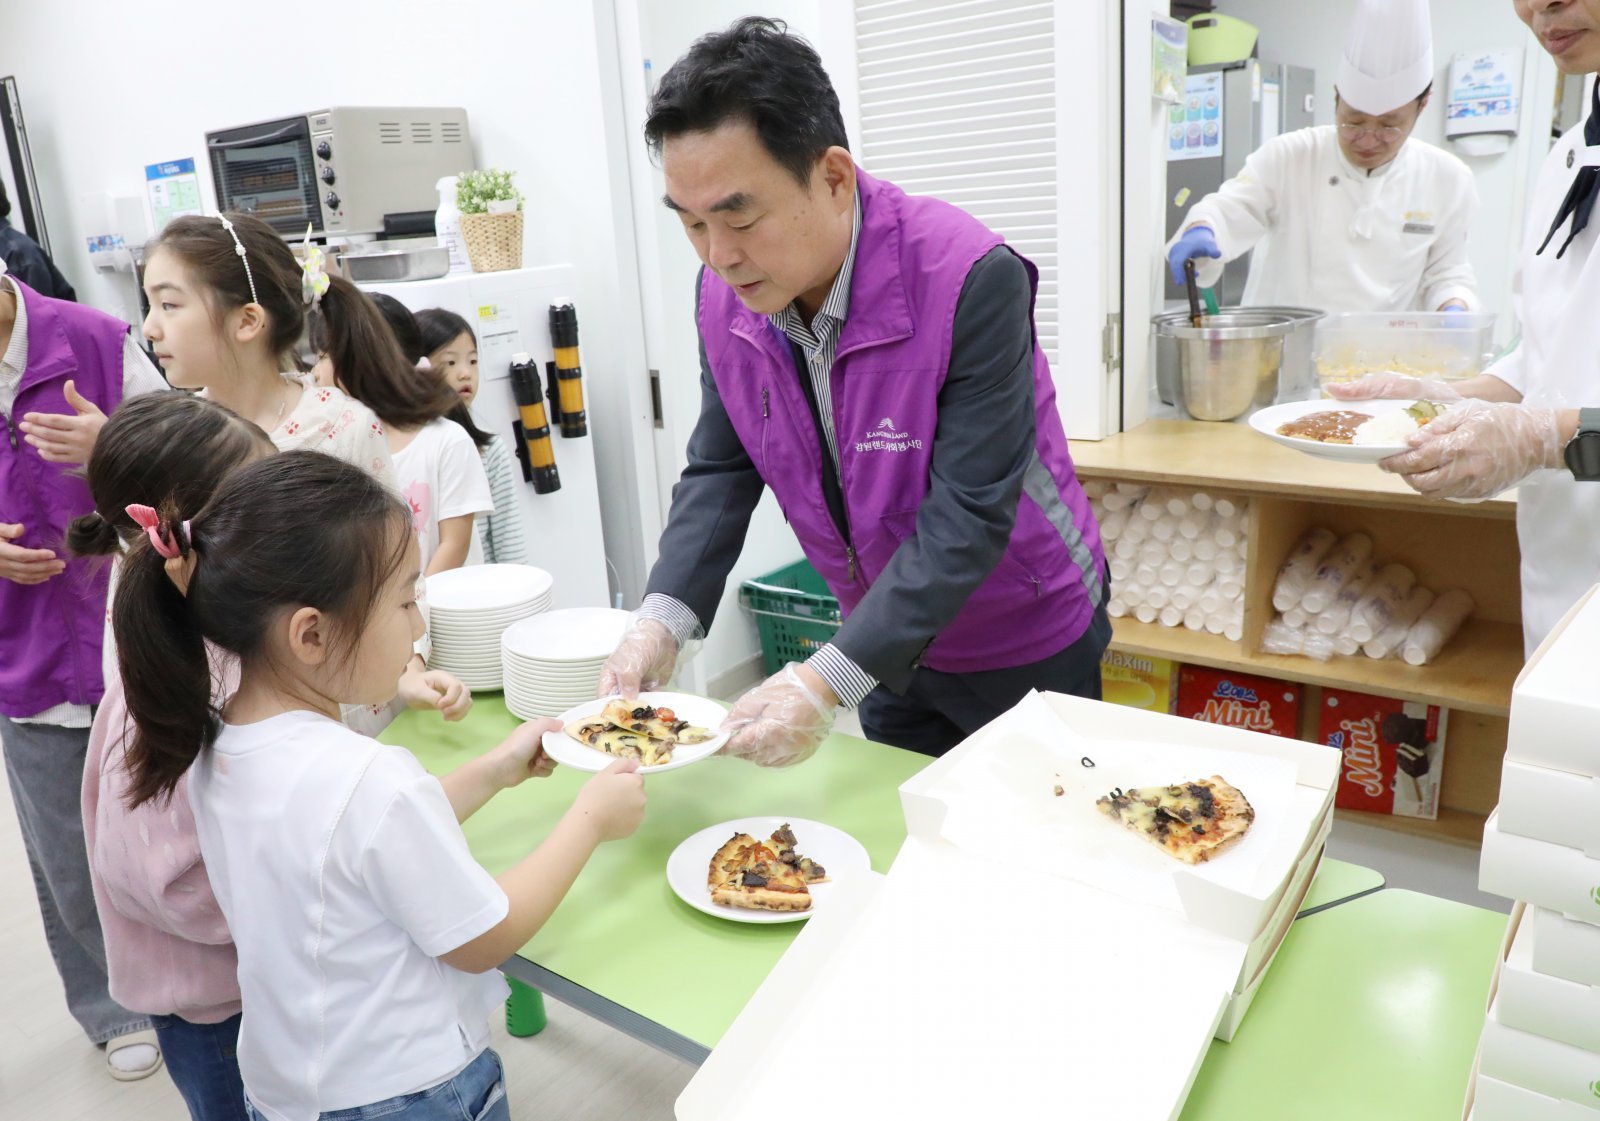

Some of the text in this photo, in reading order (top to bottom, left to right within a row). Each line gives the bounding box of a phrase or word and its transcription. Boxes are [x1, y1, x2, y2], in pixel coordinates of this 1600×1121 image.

[1102, 650, 1153, 672] Maxim
[1194, 699, 1274, 730] Mini
[1340, 717, 1384, 797] Mini
